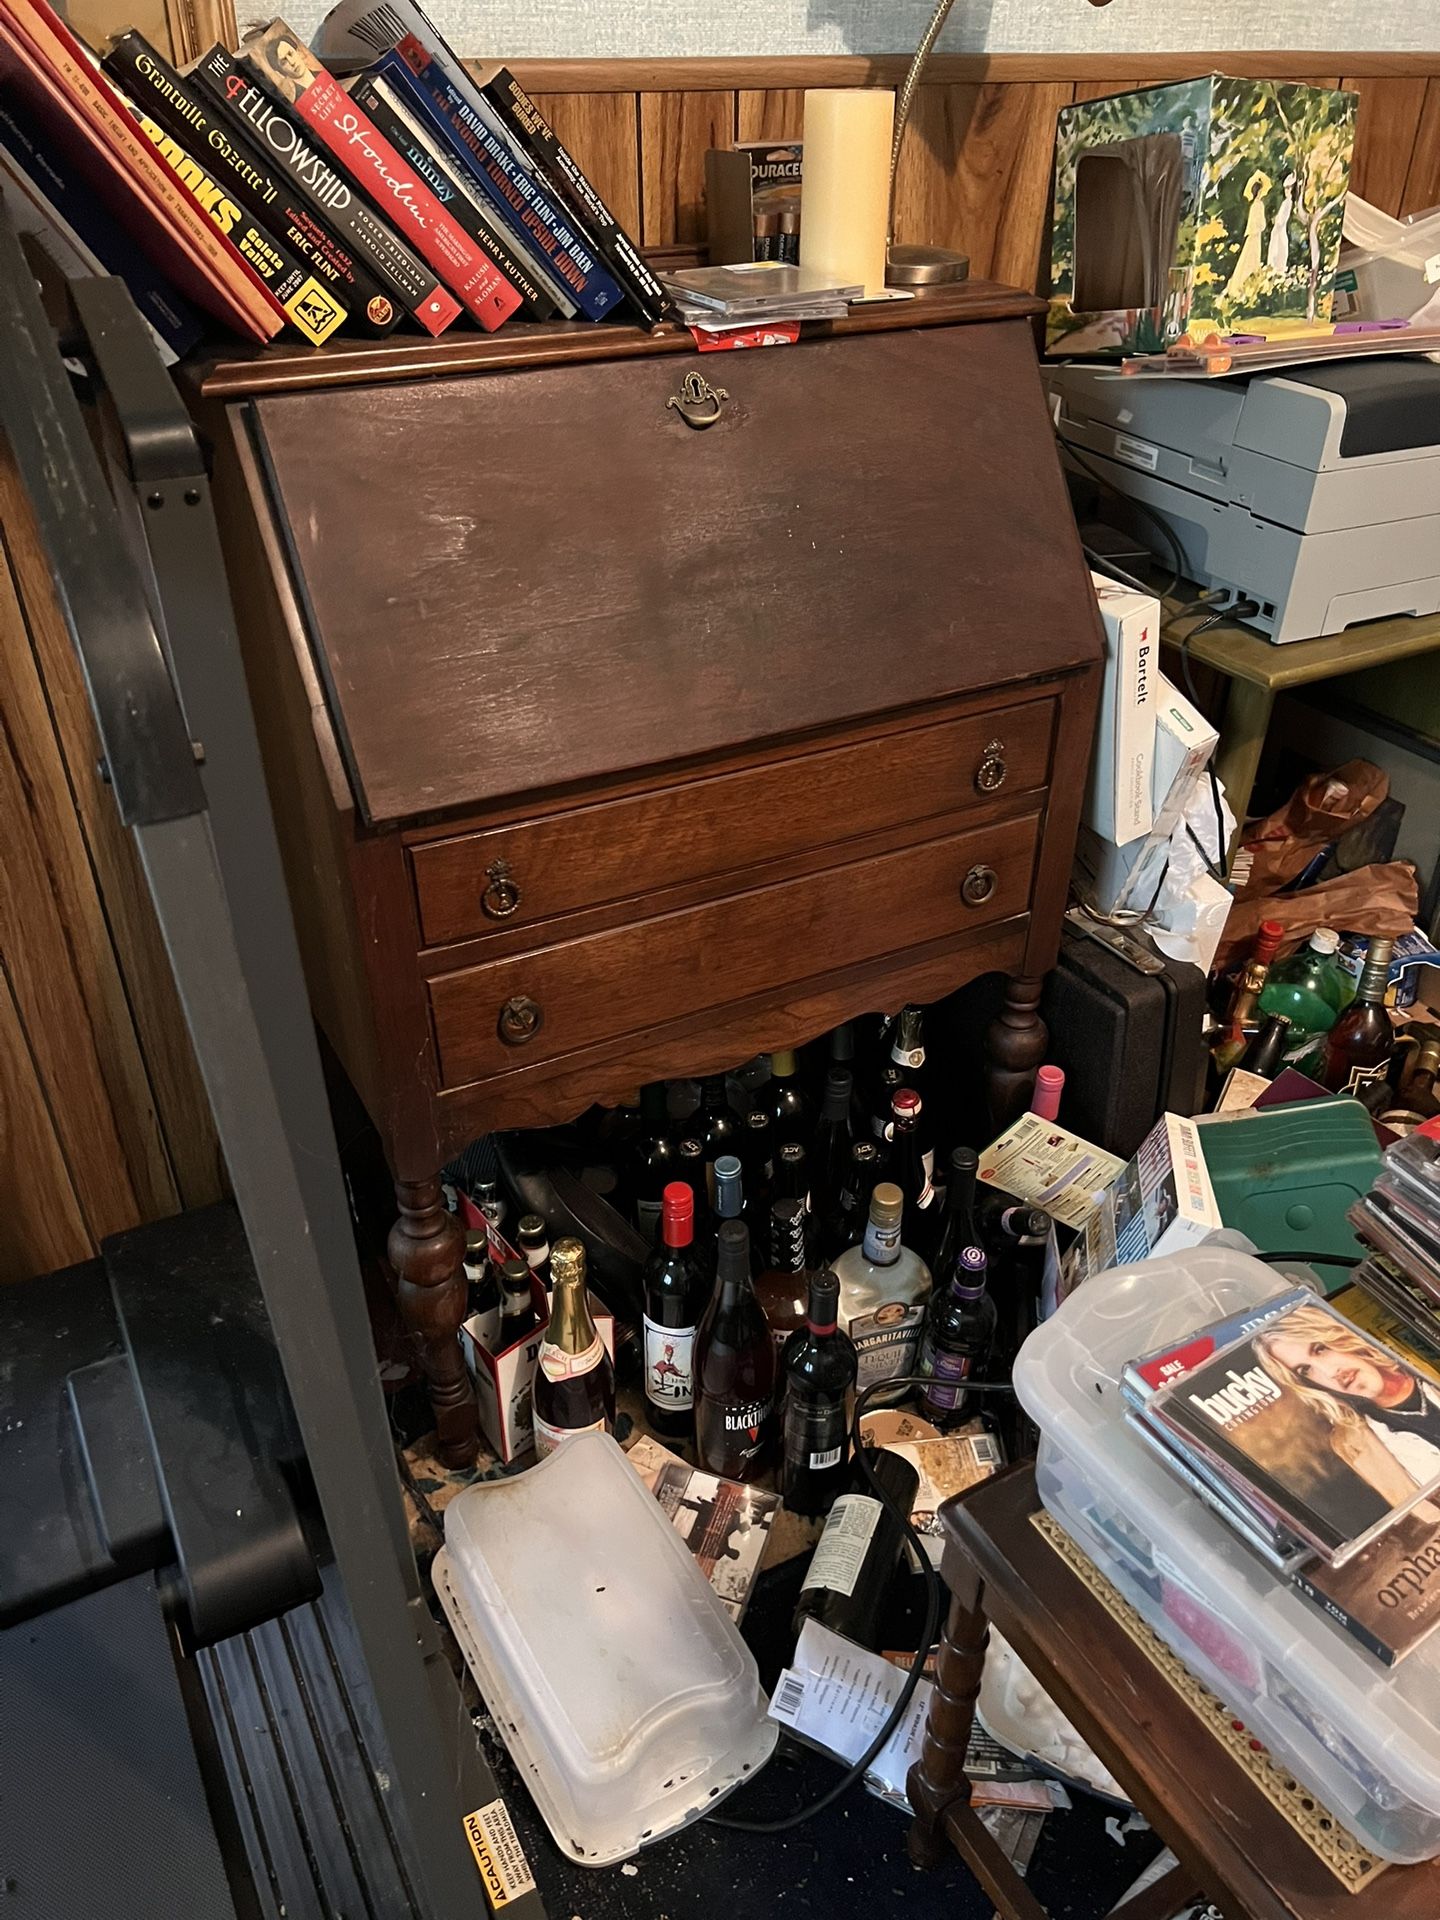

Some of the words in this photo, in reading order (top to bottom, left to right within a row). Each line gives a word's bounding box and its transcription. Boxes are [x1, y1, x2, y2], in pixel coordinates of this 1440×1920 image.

[207, 53, 230, 77] THE
[310, 83, 338, 114] SECRET
[319, 102, 335, 120] LIFE
[508, 81, 535, 113] BODIES
[530, 109, 554, 142] WE'VE
[134, 53, 208, 132] Grantville
[208, 128, 262, 191] Gazette
[511, 102, 537, 136] BURIED
[225, 74, 351, 210] FELLOWSHIP
[334, 114, 434, 229] Houdini
[407, 148, 455, 202] mimzy
[556, 146, 572, 164] Inside
[577, 176, 599, 202] National
[594, 200, 616, 226] Forensic
[752, 163, 802, 178] DURACE
[431, 88, 450, 113] THE
[451, 114, 486, 160] WORLD
[487, 160, 525, 211] TURNED
[521, 208, 561, 256] UPSIDE
[553, 250, 588, 293] DOWN
[457, 104, 487, 140] DAVID
[484, 133, 514, 176] DRAKE
[512, 172, 536, 207] ERIC
[531, 192, 557, 228] FLINT
[552, 223, 573, 252] JIM
[568, 244, 593, 275] BAEN
[553, 155, 579, 185] Academy,
[582, 193, 600, 216] World's
[595, 213, 609, 228] Top
[285, 207, 308, 233] Edited
[307, 231, 321, 245] and
[321, 243, 345, 270] Created
[301, 211, 325, 238] Sequels
[239, 241, 276, 278] Valley
[245, 228, 285, 270] Goleta
[286, 225, 311, 251] ERIC
[310, 250, 341, 281] FLINT
[356, 228, 386, 260] HAROLD
[386, 260, 418, 297] ZELLMAN
[357, 210, 383, 240] ROGER
[384, 239, 426, 288] FRIEDLAND
[477, 228, 505, 261] HENRY
[504, 260, 540, 302] KUTTNER
[274, 282, 288, 298] KEEP
[287, 269, 302, 284] UNTIL
[280, 286, 295, 300] JUNE
[464, 264, 490, 292] KALUSH
[474, 275, 502, 305] SLOMAN
[1138, 646, 1150, 705] Bartelt
[1133, 753, 1144, 799] Cookbook
[1133, 800, 1142, 826] Stand
[1159, 1359, 1185, 1376] SALE
[1188, 1366, 1282, 1426] bucky
[1224, 1394, 1278, 1432] COVINGTON
[1377, 1538, 1440, 1608] orpha
[483, 1813, 491, 1828] FEET
[490, 1808, 502, 1827] AREA
[498, 1825, 507, 1843] THIS
[499, 1806, 515, 1844] TREADMILL
[466, 1816, 501, 1891] CAUTION
[489, 1830, 500, 1845] AND
[504, 1843, 516, 1864] FROM
[513, 1844, 521, 1858] THE
[495, 1846, 509, 1872] HANDS
[512, 1864, 525, 1885] AWAY
[519, 1858, 531, 1881] WHILE
[505, 1871, 517, 1890] KEEP
